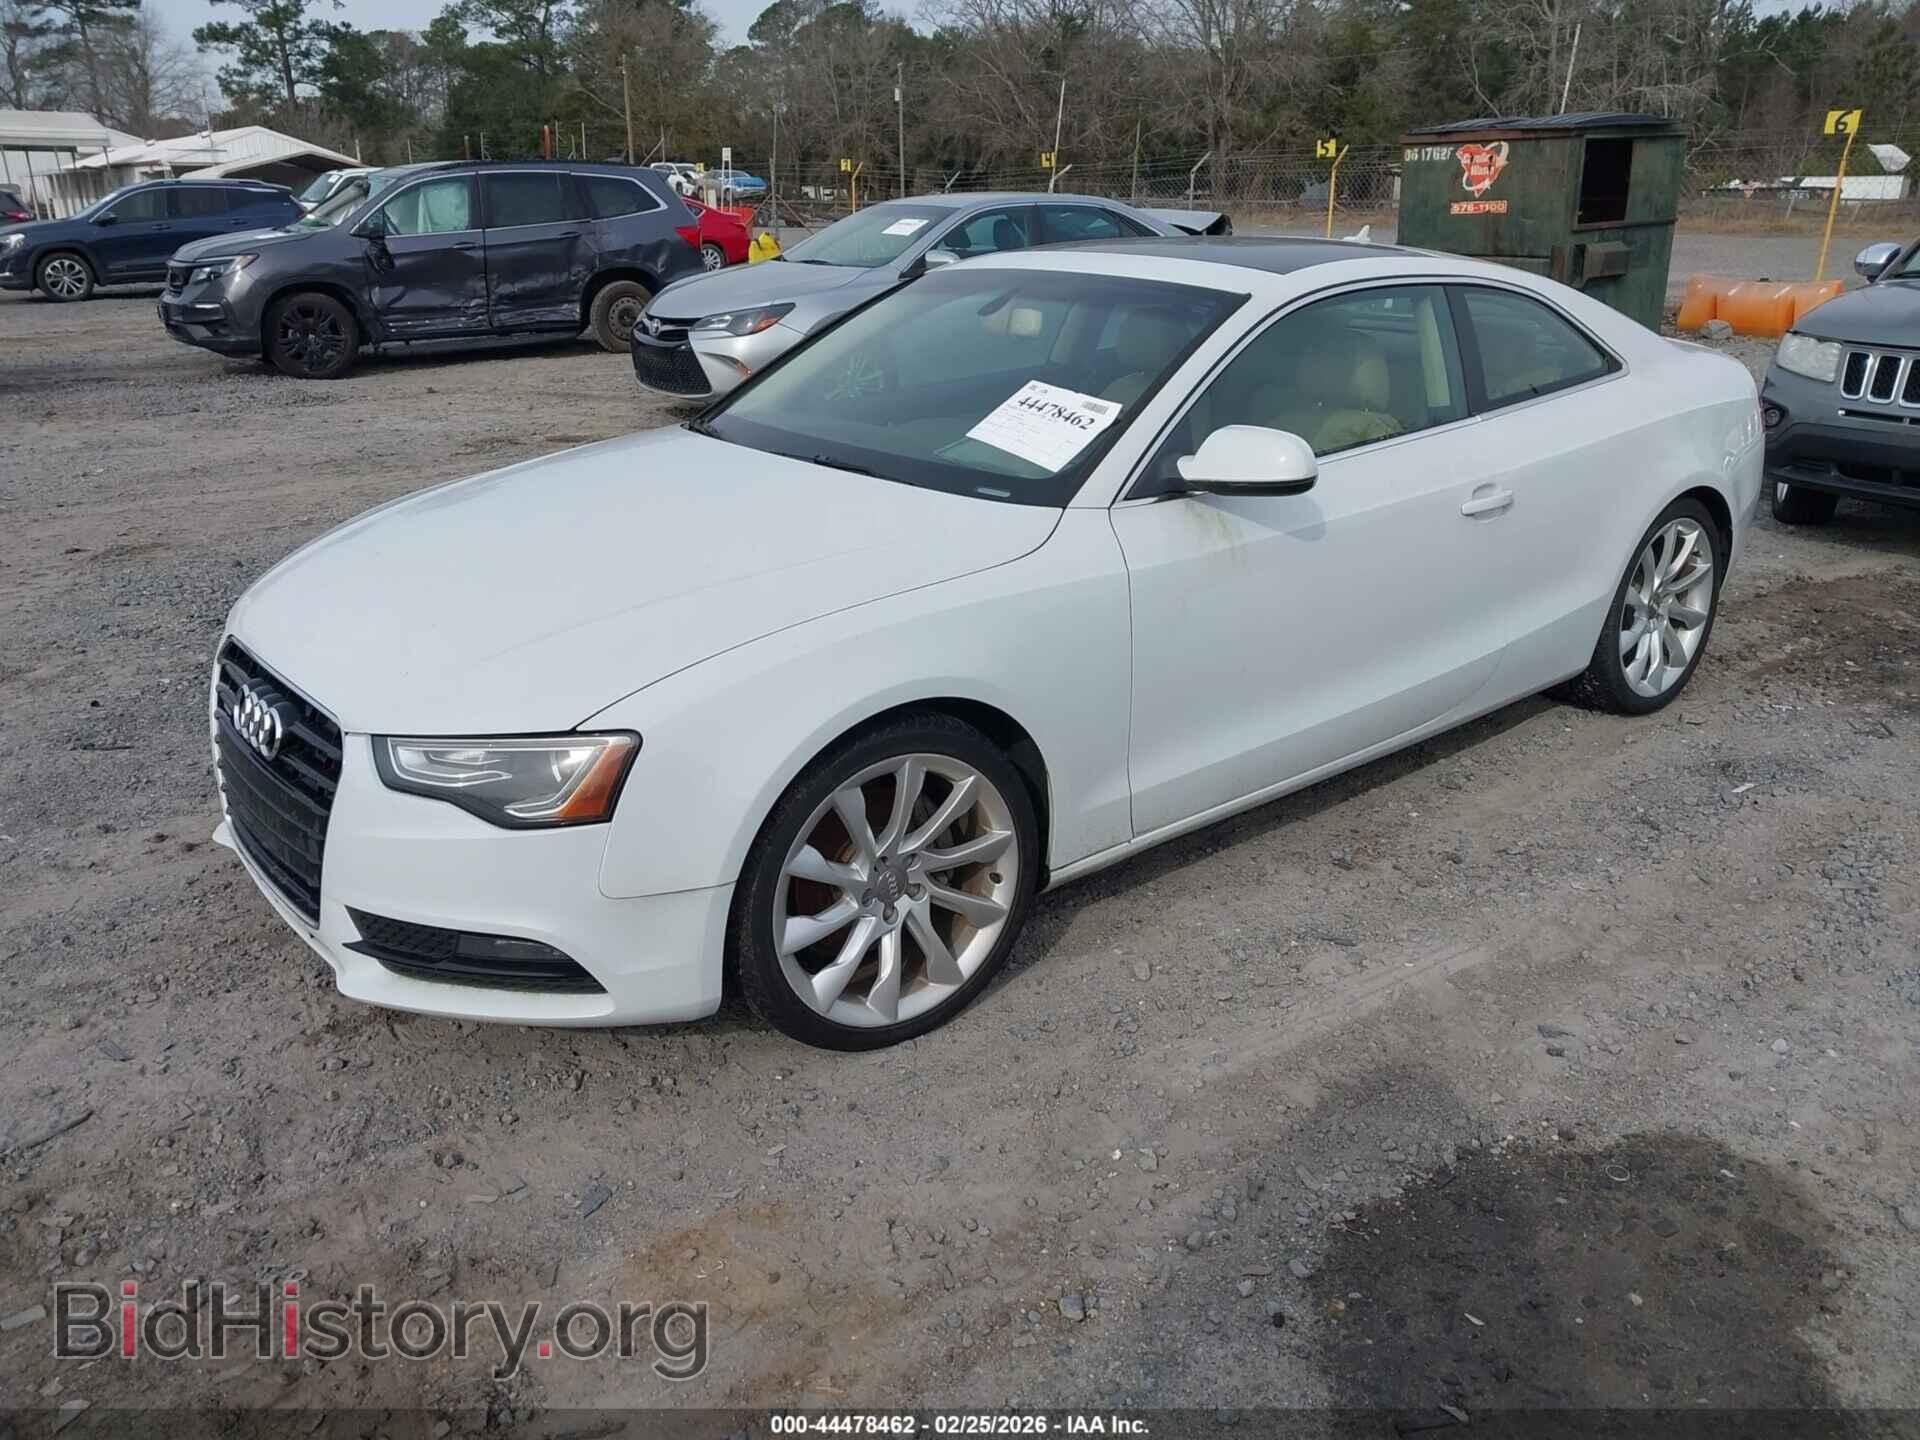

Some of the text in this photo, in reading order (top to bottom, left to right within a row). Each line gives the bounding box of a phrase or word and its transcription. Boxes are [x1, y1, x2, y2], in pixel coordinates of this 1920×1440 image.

[1834, 110, 1850, 134] 6
[1319, 138, 1331, 158] 5
[1018, 396, 1096, 430] 44478462
